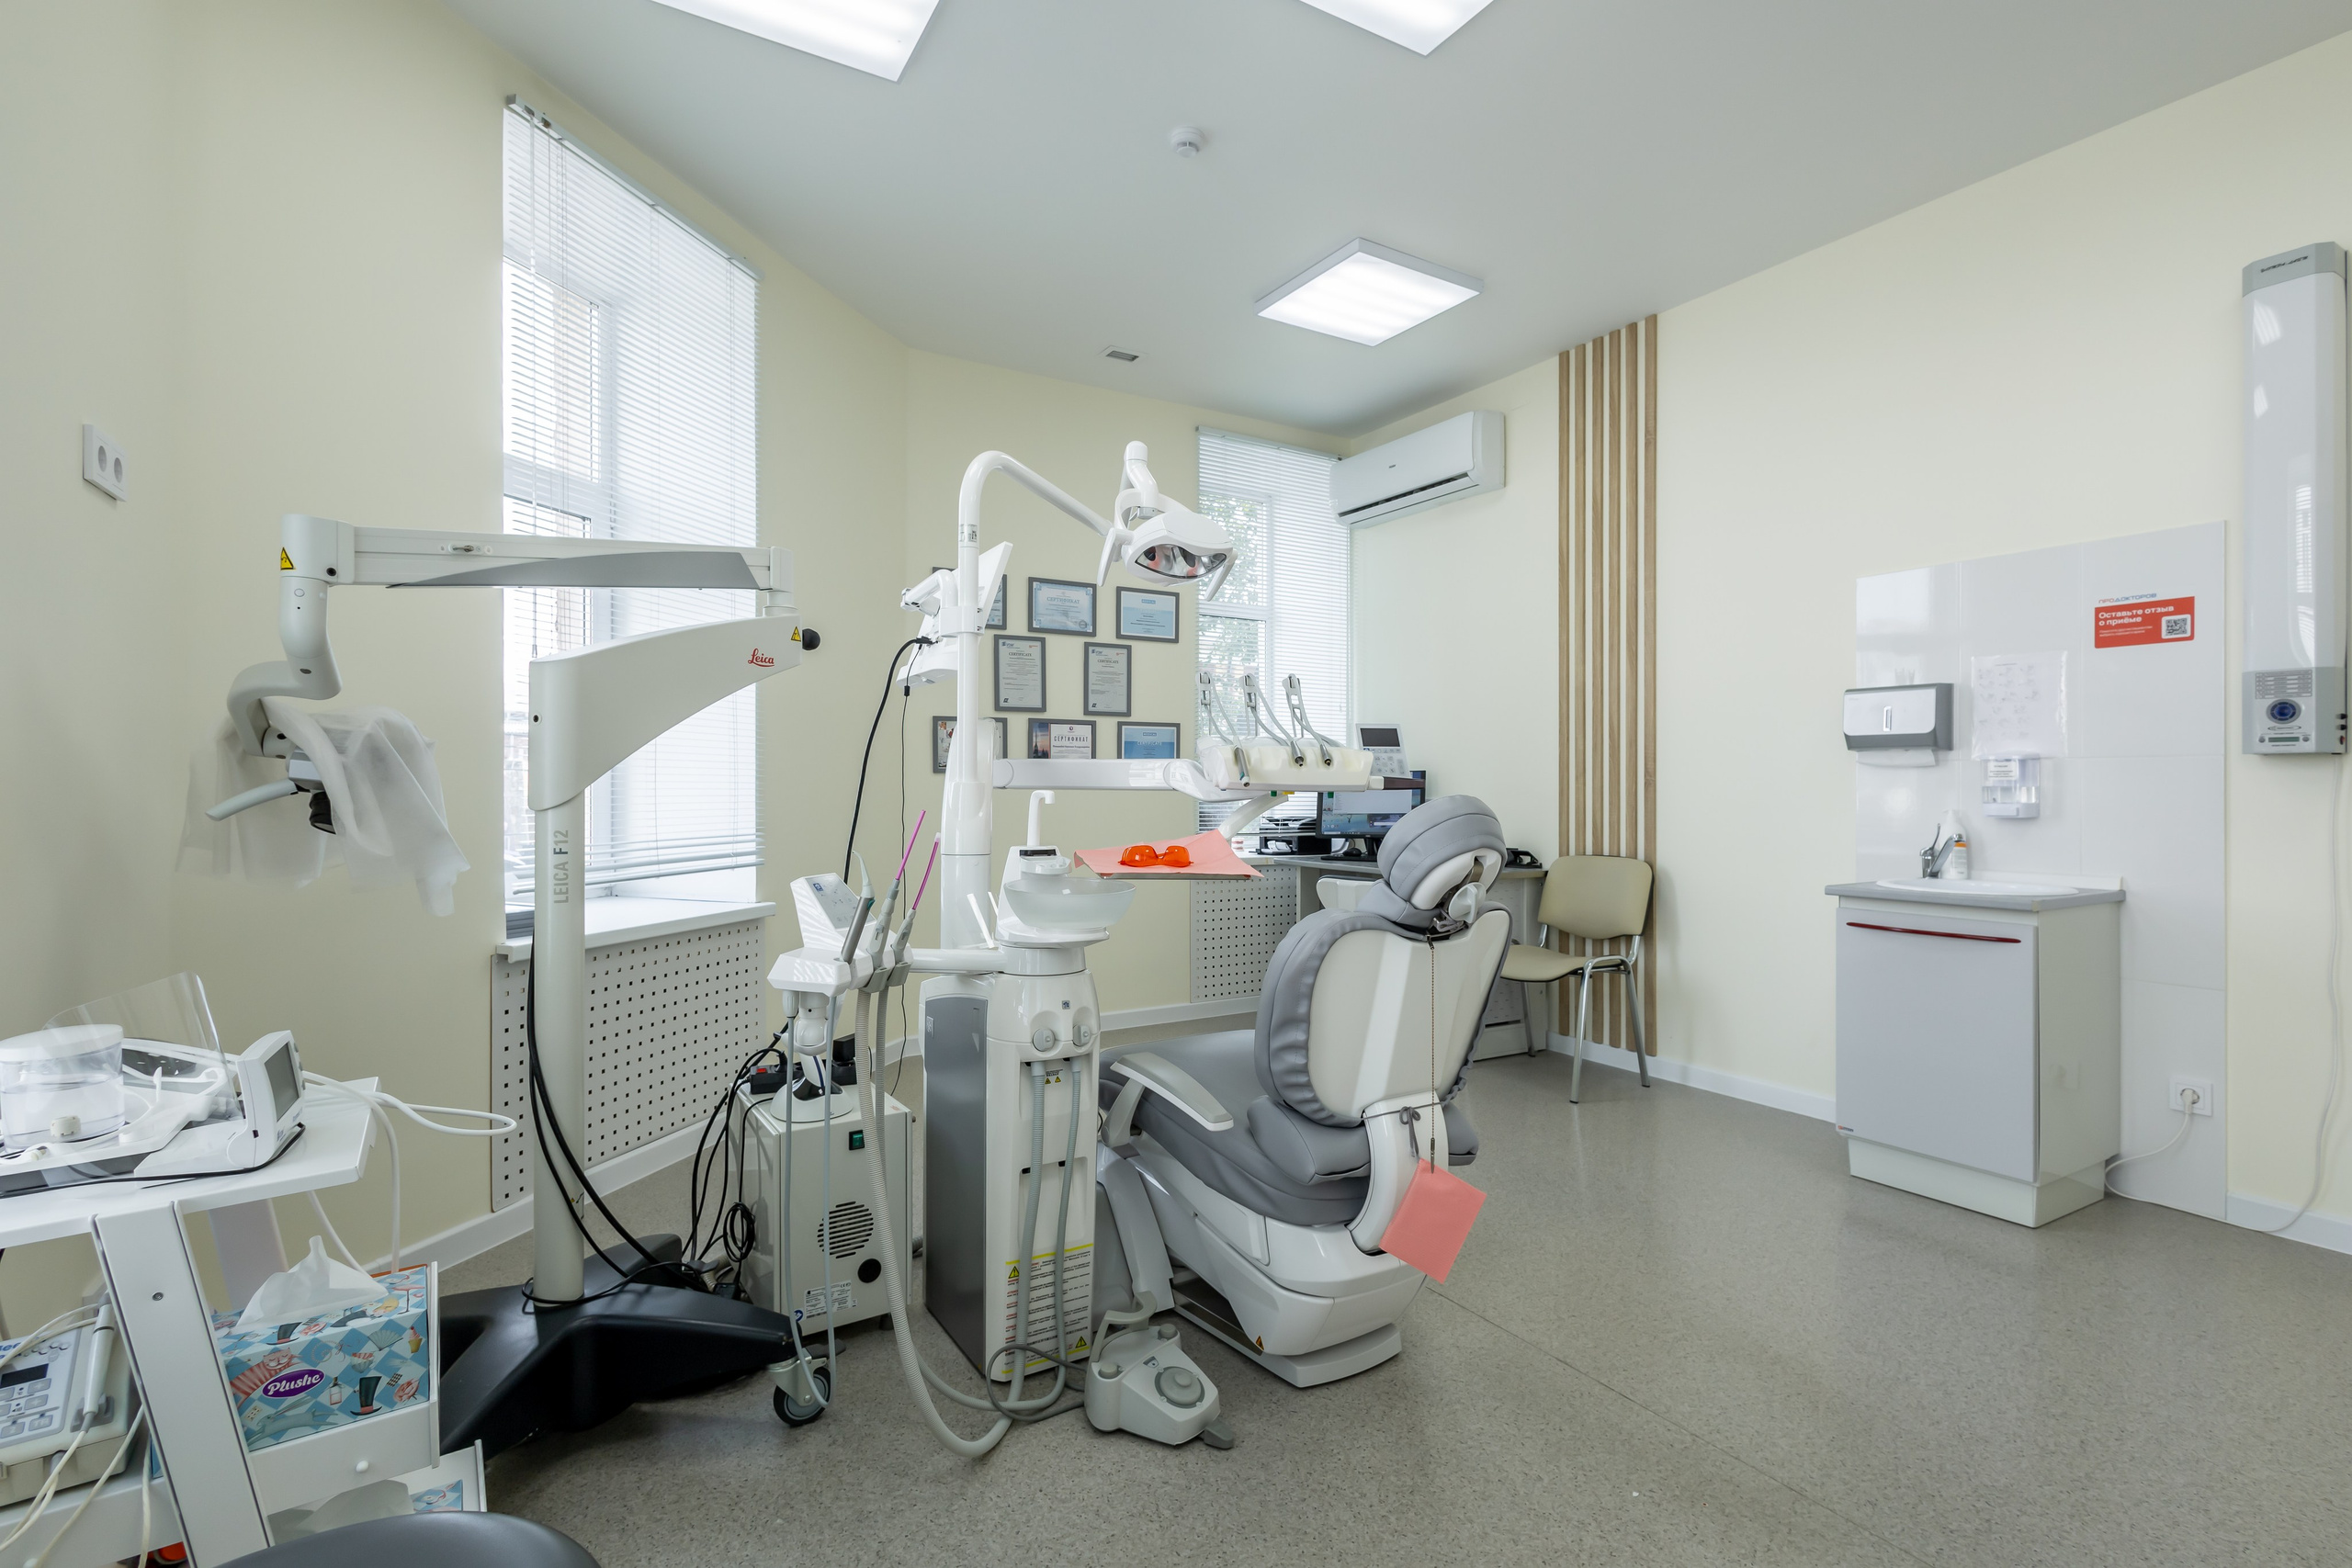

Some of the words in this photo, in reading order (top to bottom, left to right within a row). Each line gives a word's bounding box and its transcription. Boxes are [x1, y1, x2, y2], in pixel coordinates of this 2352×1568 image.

[2098, 609, 2143, 619] Оставьте
[2144, 605, 2175, 615] отзыв
[2107, 616, 2143, 626] приёме
[747, 648, 775, 668] Leica
[553, 829, 569, 855] F12
[553, 861, 569, 904] LEICA
[267, 1374, 321, 1395] Plushe
